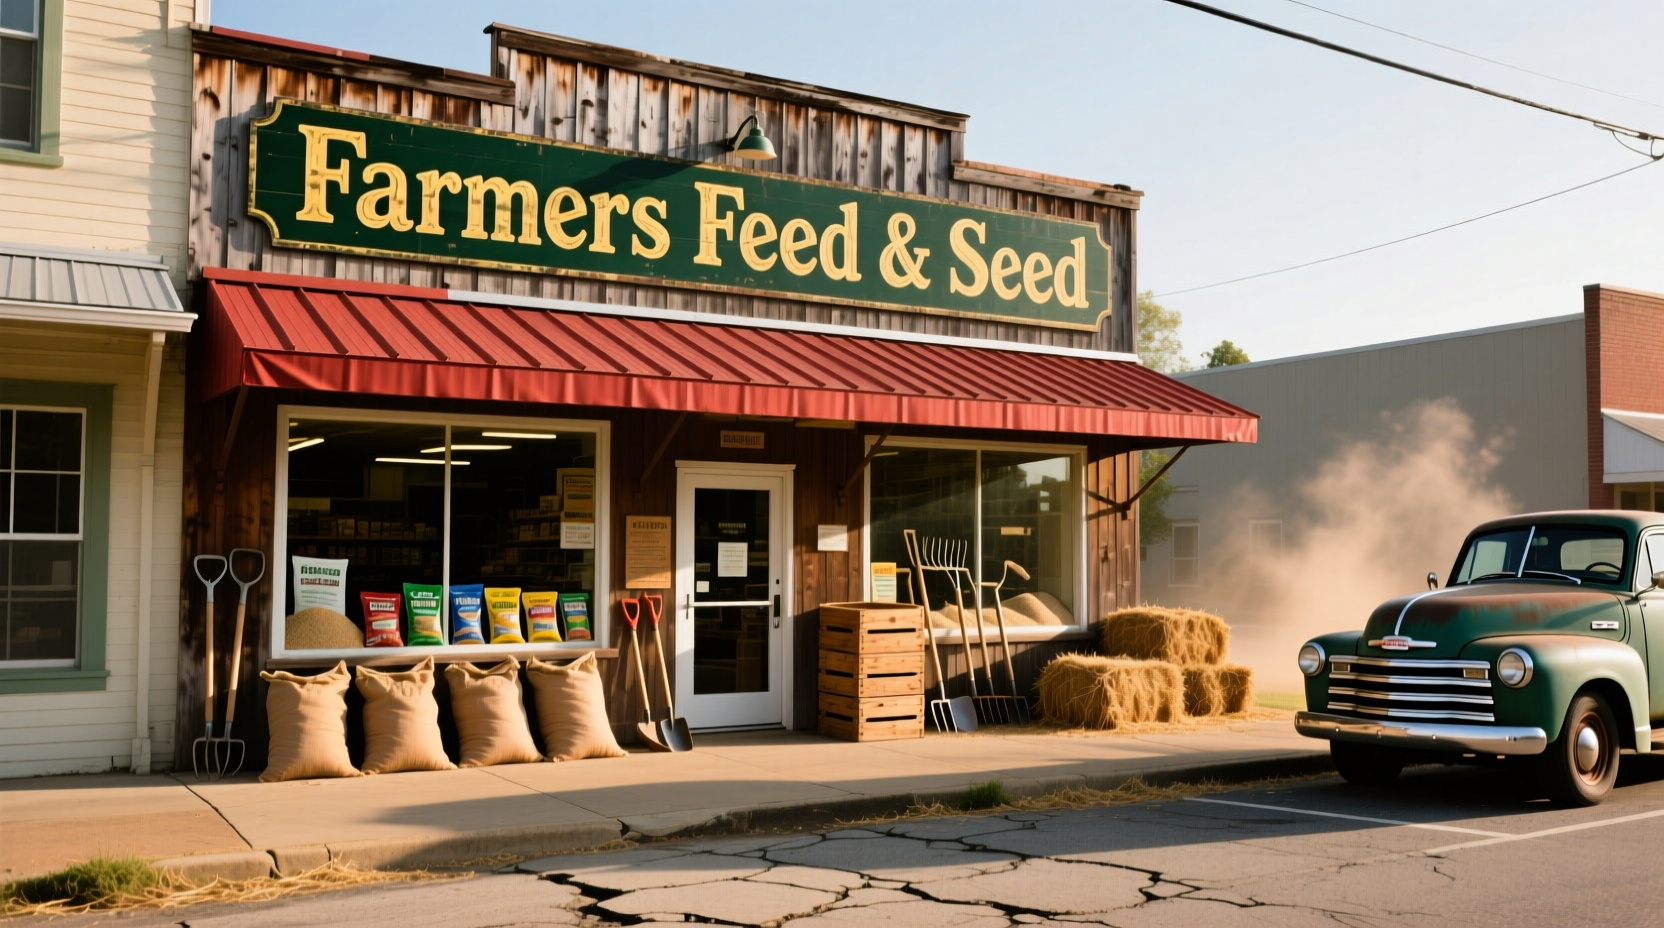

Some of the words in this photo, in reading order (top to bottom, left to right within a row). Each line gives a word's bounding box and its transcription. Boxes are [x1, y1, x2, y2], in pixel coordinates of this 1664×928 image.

[295, 124, 671, 260] Farmers
[693, 181, 862, 282] Feed
[879, 212, 931, 290] &
[949, 218, 1090, 309] Seed
